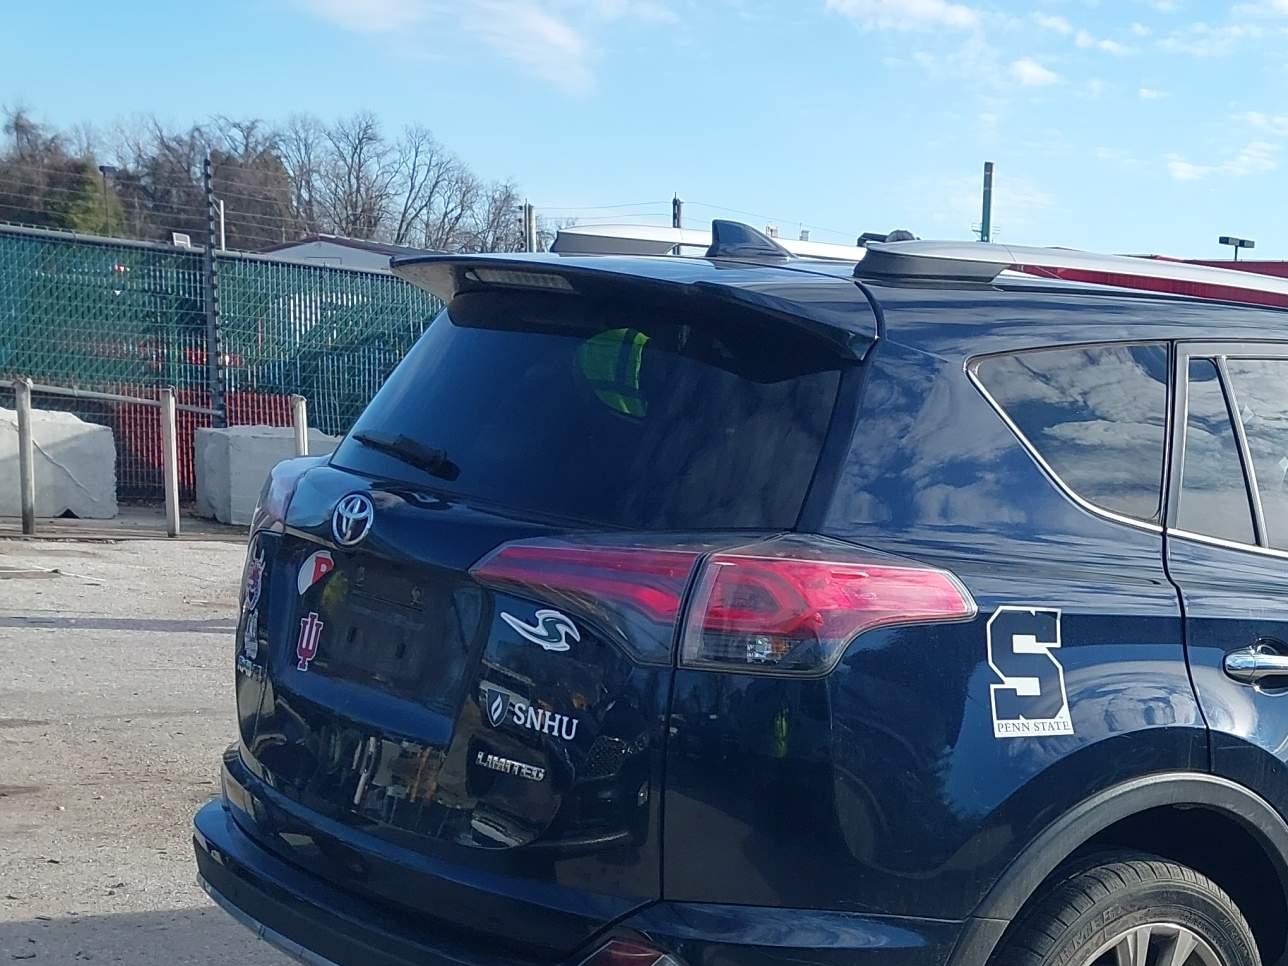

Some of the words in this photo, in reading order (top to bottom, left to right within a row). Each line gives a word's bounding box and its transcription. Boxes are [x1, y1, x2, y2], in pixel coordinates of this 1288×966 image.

[512, 703, 579, 740] SNHU
[997, 722, 1031, 733] PENN
[1034, 720, 1071, 733] STATE
[476, 751, 546, 781] LIMITED
